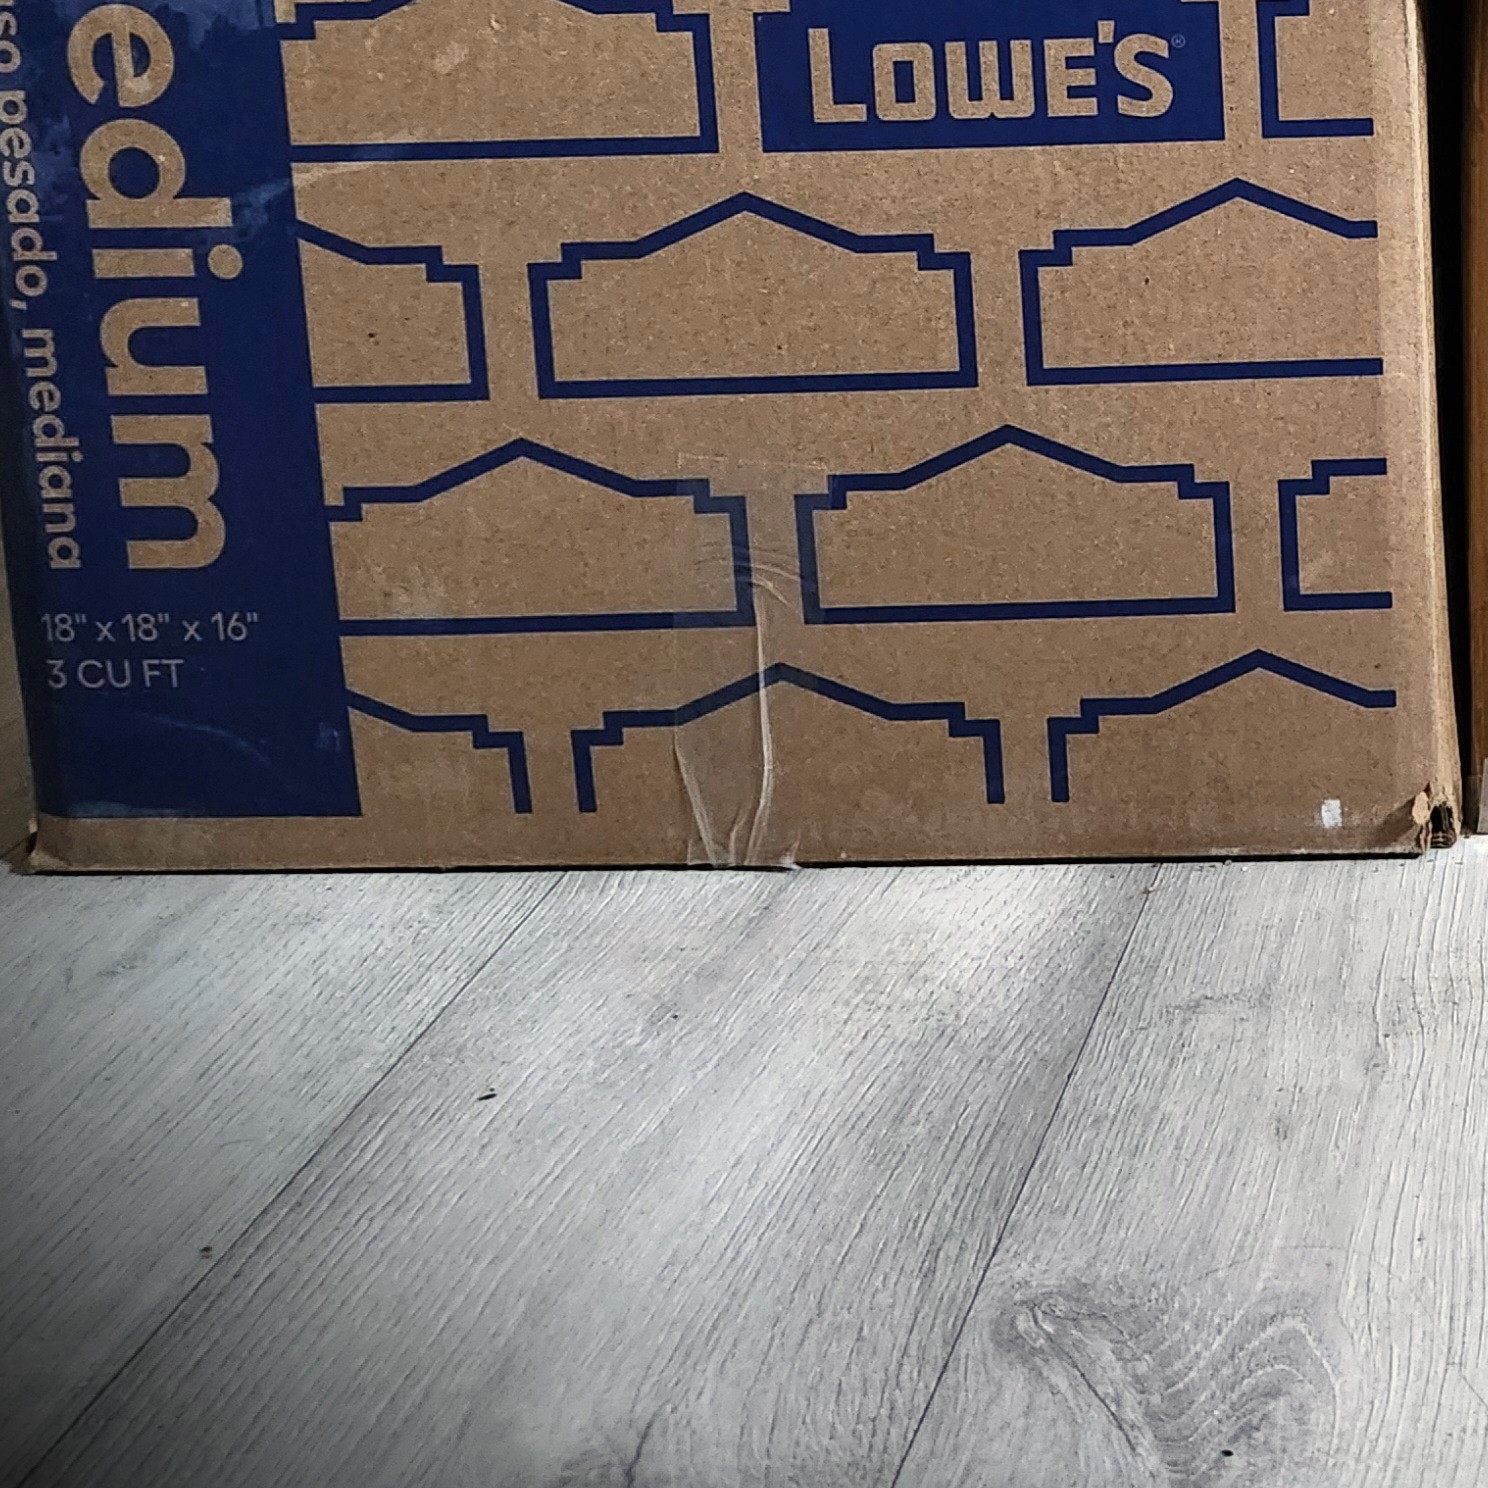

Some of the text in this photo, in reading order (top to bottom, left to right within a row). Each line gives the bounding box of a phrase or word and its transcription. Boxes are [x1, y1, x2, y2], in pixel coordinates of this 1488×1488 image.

[0, 89, 58, 310] pesado,
[21, 328, 87, 571] mediana
[47, 658, 184, 690] 3 CU FT
[96, 621, 116, 643] x
[182, 621, 203, 643] x
